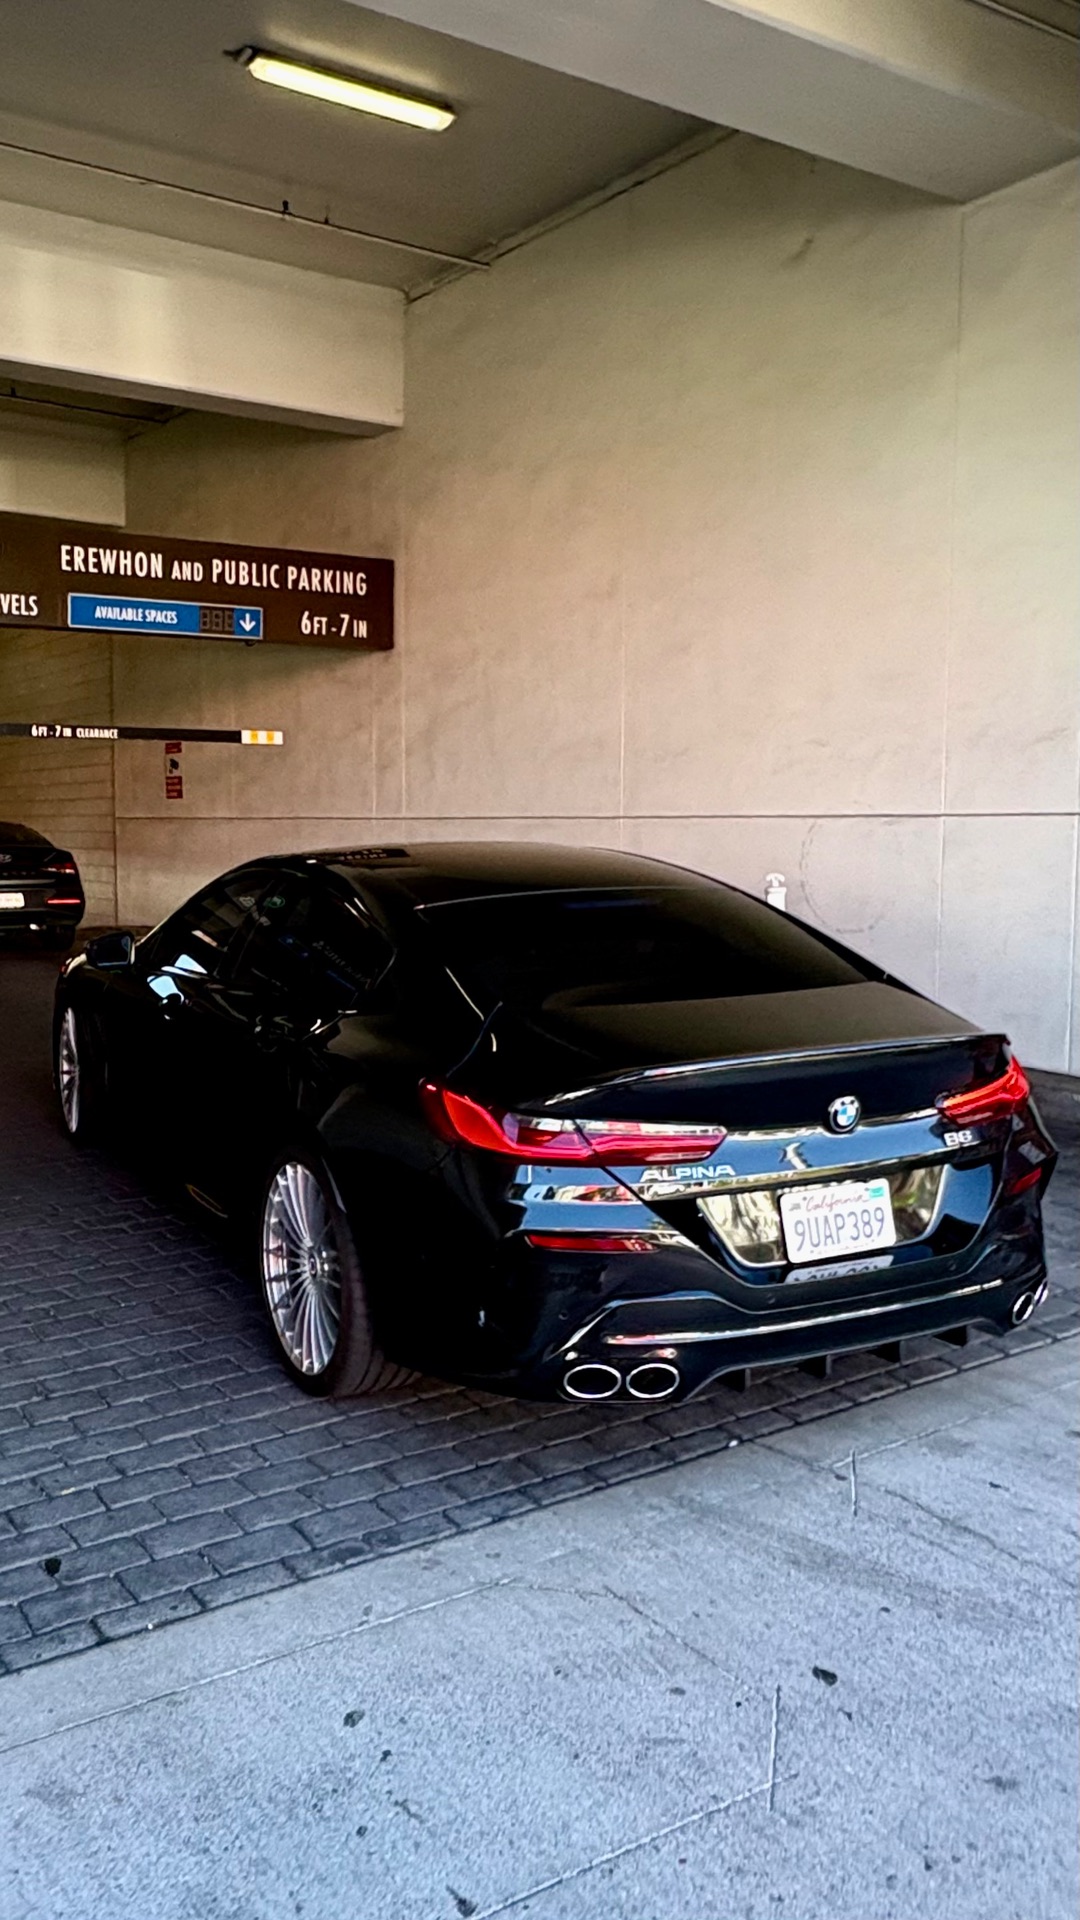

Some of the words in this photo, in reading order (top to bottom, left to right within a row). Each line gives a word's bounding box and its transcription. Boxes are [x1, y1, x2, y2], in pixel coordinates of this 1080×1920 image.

[61, 545, 163, 578] EREWHON
[171, 560, 203, 582] AND
[212, 559, 280, 588] PUBLIC
[287, 566, 367, 596] PARKING
[95, 606, 143, 622] AVAILABLE
[145, 609, 178, 624] SPACES
[76, 728, 118, 739] CLEARANCE
[640, 1165, 736, 1182] ALPINA
[805, 1193, 870, 1213] California
[794, 1207, 885, 1252] 9UAP389
